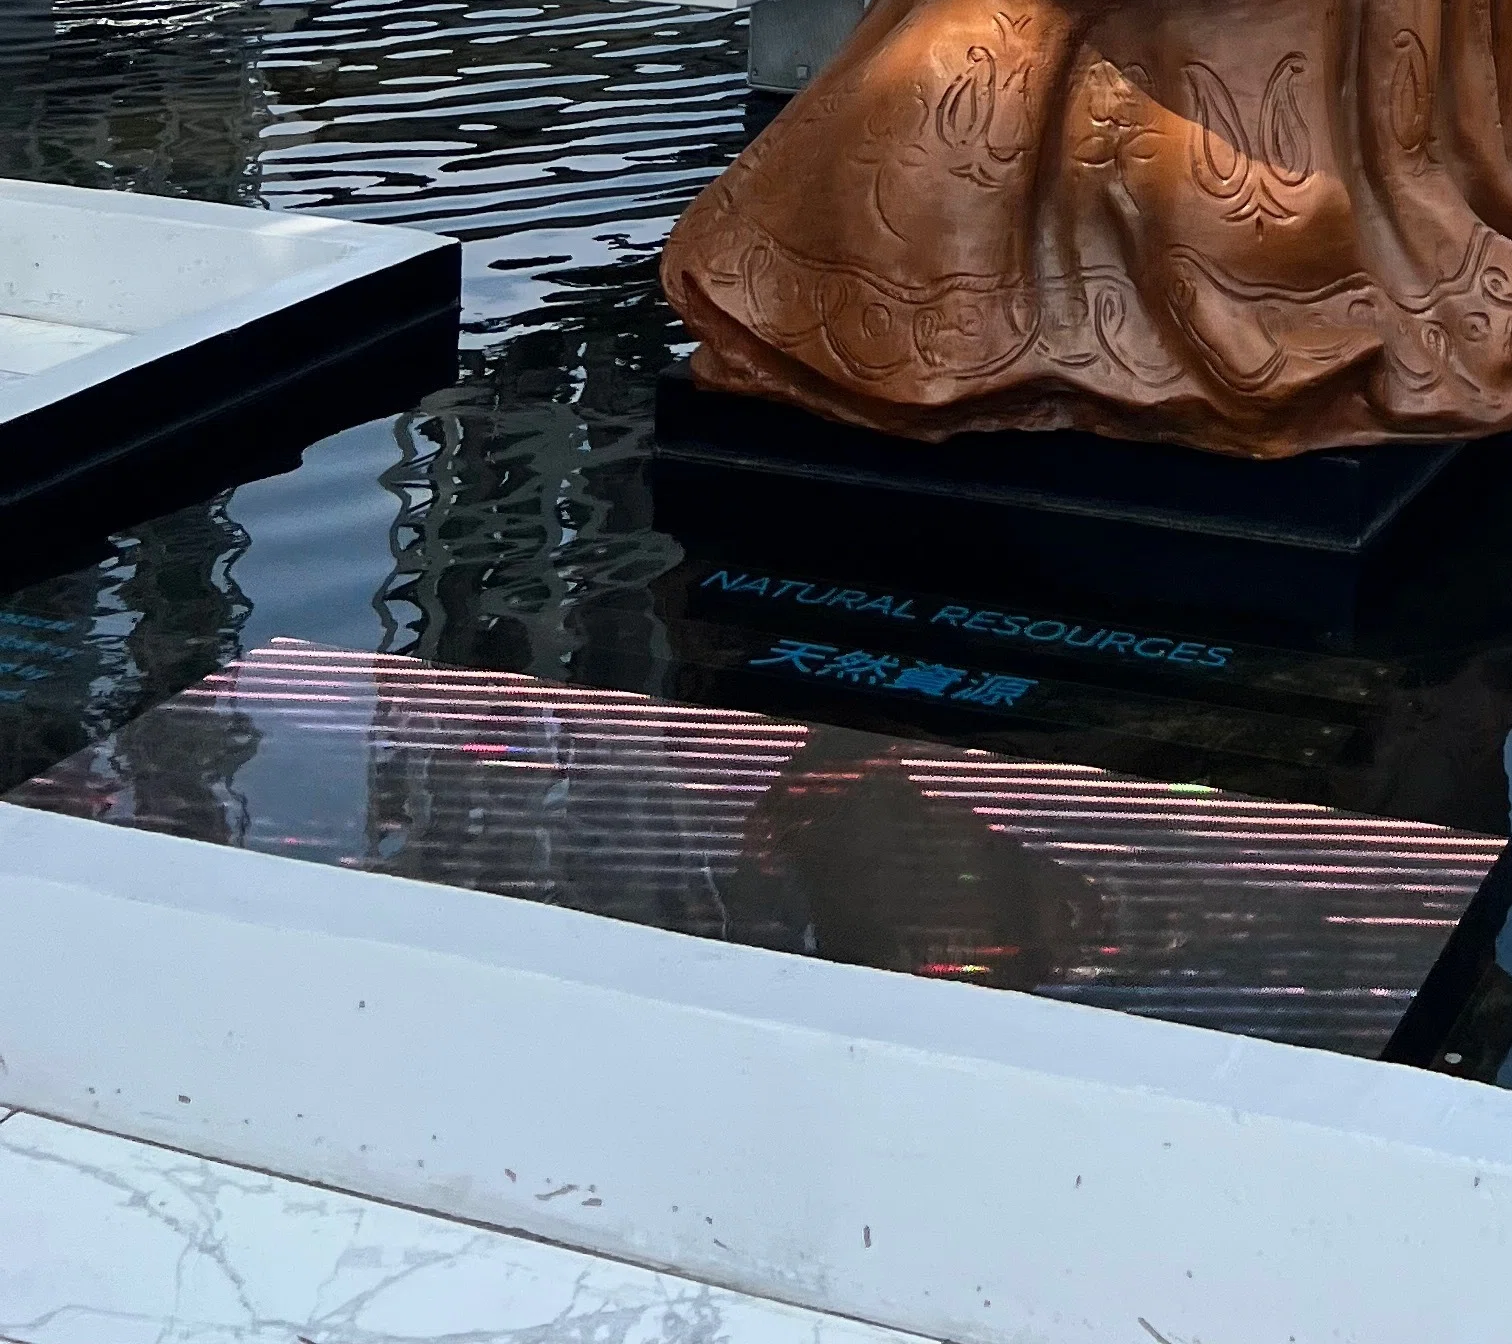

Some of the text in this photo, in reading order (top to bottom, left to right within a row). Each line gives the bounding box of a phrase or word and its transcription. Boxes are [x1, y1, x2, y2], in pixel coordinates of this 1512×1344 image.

[701, 570, 1234, 668] NATURAL RESOURCES
[749, 639, 1039, 707] 天然資源
